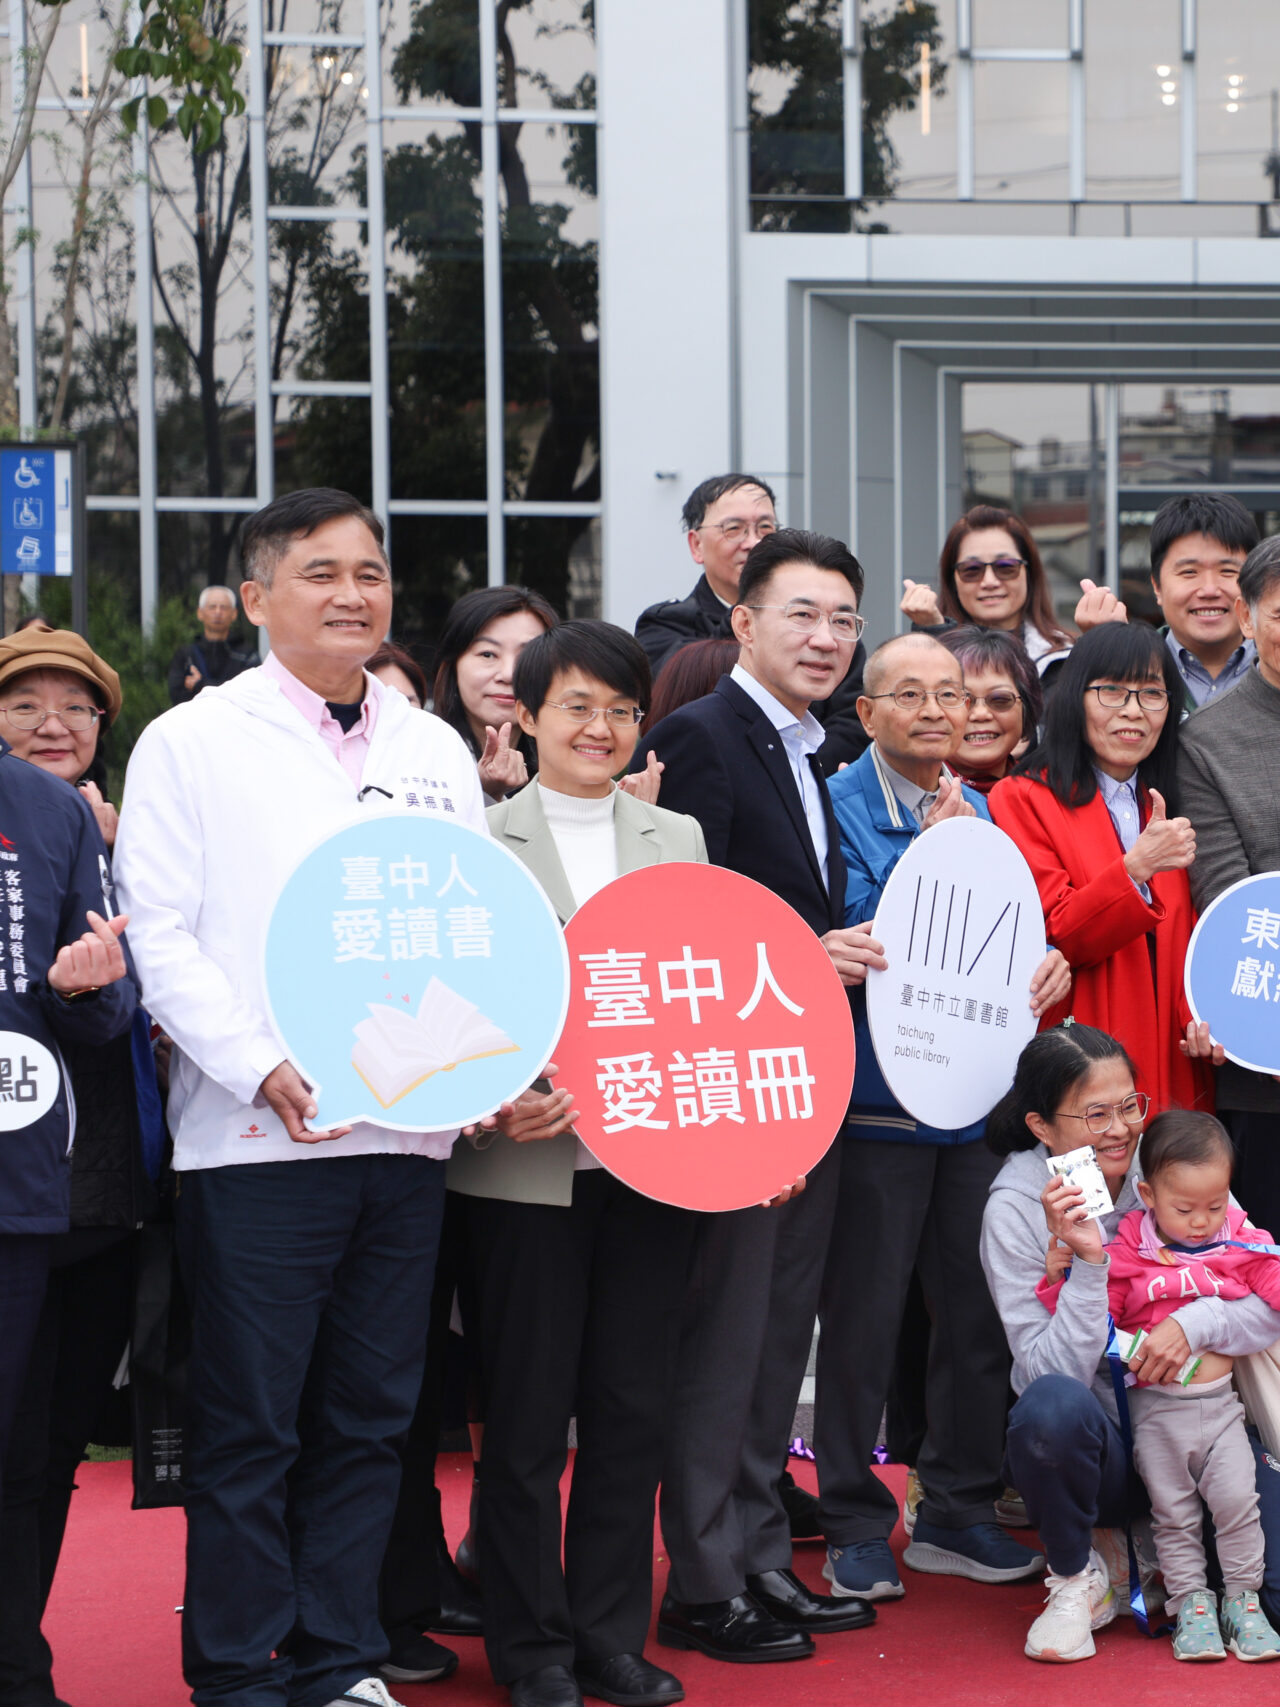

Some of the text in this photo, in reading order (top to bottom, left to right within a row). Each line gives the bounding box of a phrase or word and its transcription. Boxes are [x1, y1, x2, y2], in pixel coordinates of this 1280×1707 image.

[341, 854, 479, 902] 臺中人
[4, 869, 30, 993] 客家事務委員會
[331, 905, 494, 964] 愛讀書
[579, 942, 805, 1029] 臺中人
[900, 983, 1009, 1028] 臺中市立圖書館
[894, 1045, 951, 1068] public library
[897, 1023, 935, 1044] taichung
[595, 1046, 816, 1134] 愛讀冊
[1147, 1264, 1225, 1301] GAP
